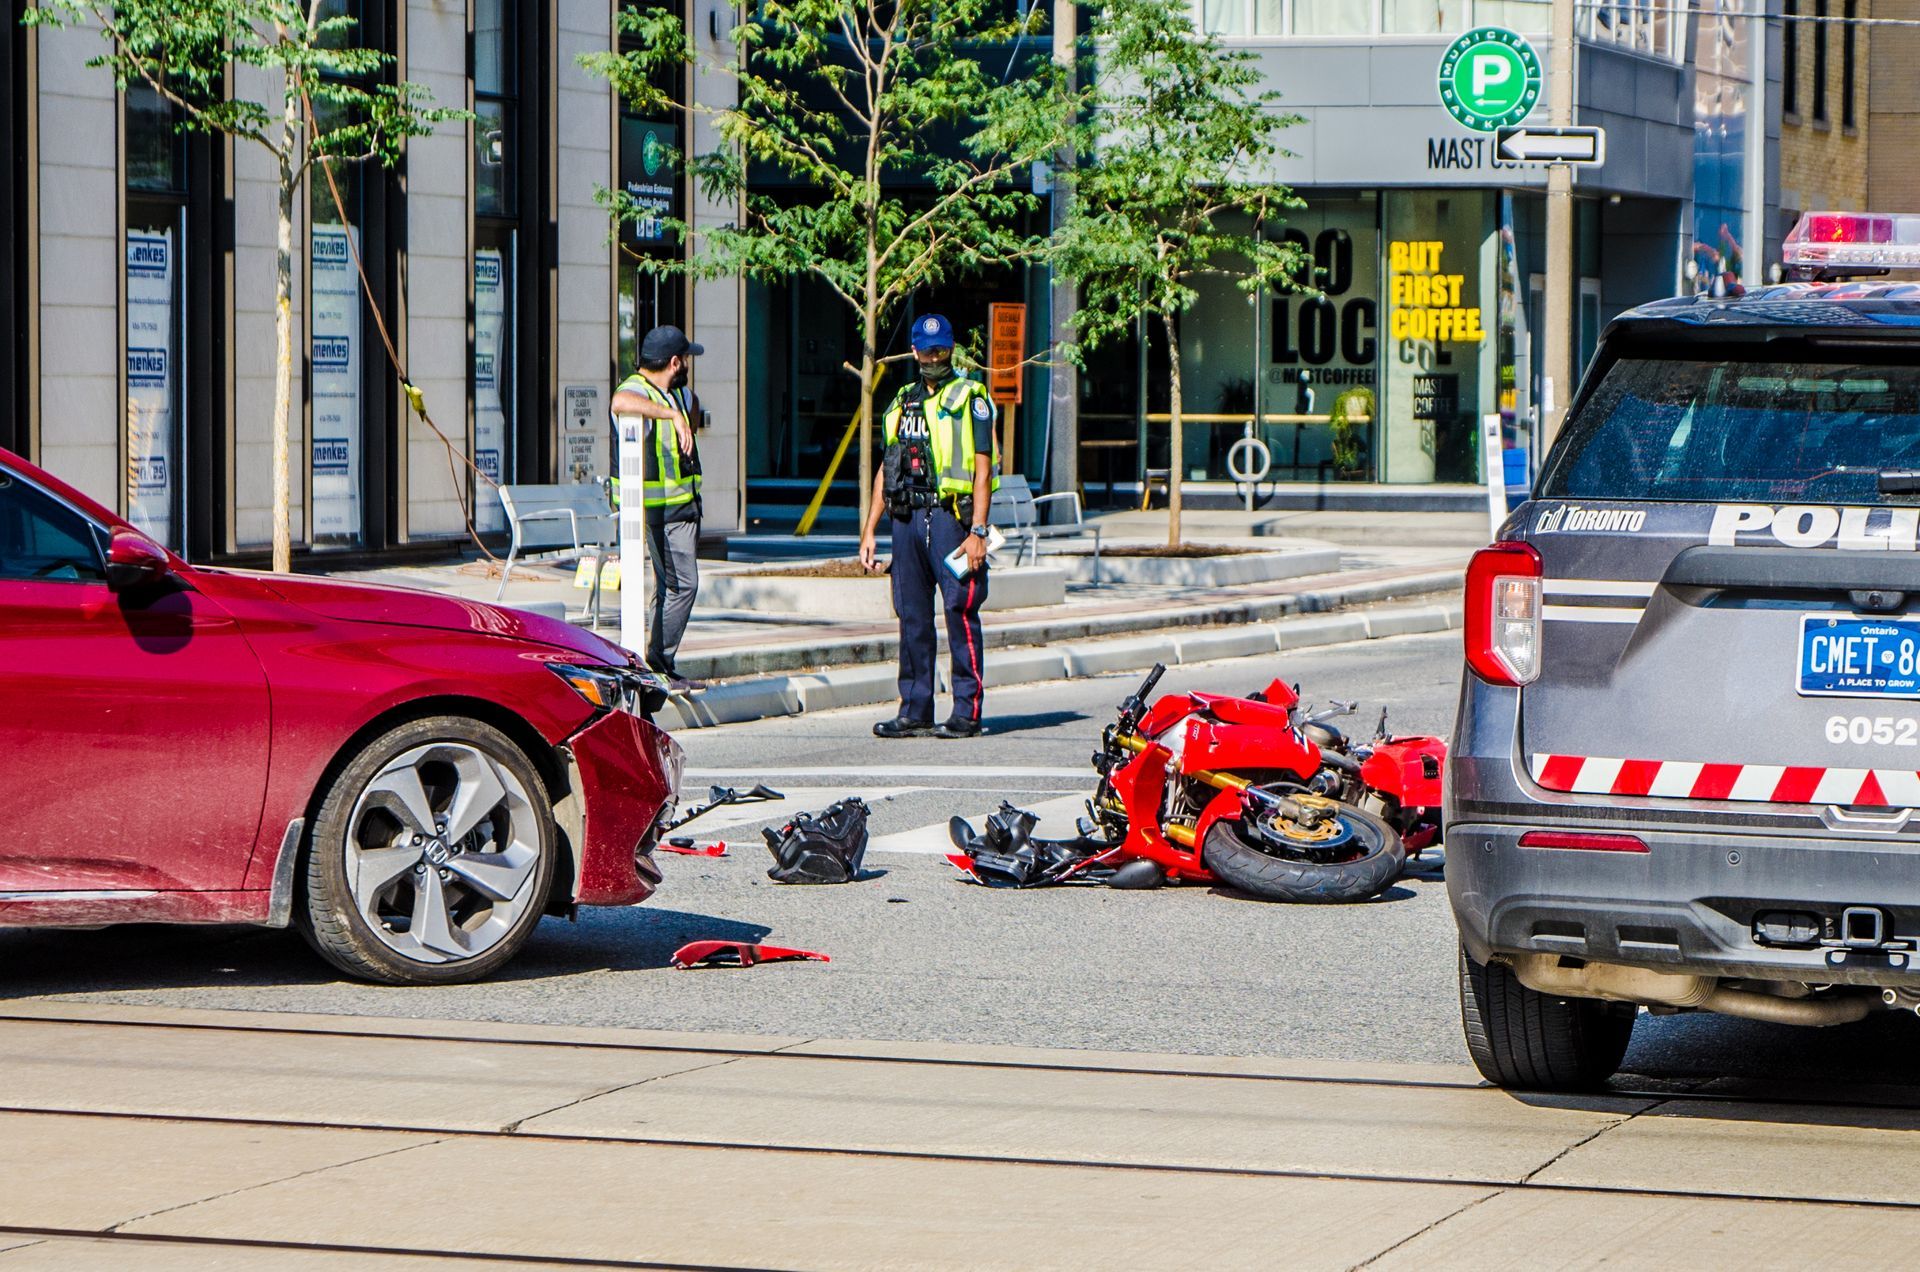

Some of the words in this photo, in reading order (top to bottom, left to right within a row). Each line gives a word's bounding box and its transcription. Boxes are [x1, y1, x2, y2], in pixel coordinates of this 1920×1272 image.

[1443, 30, 1537, 76] MUNICIPAL
[1471, 54, 1511, 96] P
[1443, 89, 1536, 129] PARKING
[1428, 137, 1486, 169] MAST
[628, 181, 653, 193] Pedestrian
[654, 183, 673, 195] Entrance
[1389, 241, 1444, 274] BUT
[1390, 274, 1464, 307] FIRST
[314, 441, 347, 461] menkes
[1562, 506, 1646, 532] TORONTO
[1709, 505, 1919, 551] POLI
[1860, 626, 1899, 636] Ontario
[1811, 636, 1879, 675] CMET
[1838, 678, 1846, 686] A
[1846, 678, 1873, 687] PLACE
[1875, 679, 1887, 687] TO
[1887, 680, 1915, 688] GROW
[1825, 716, 1919, 746] 6052
